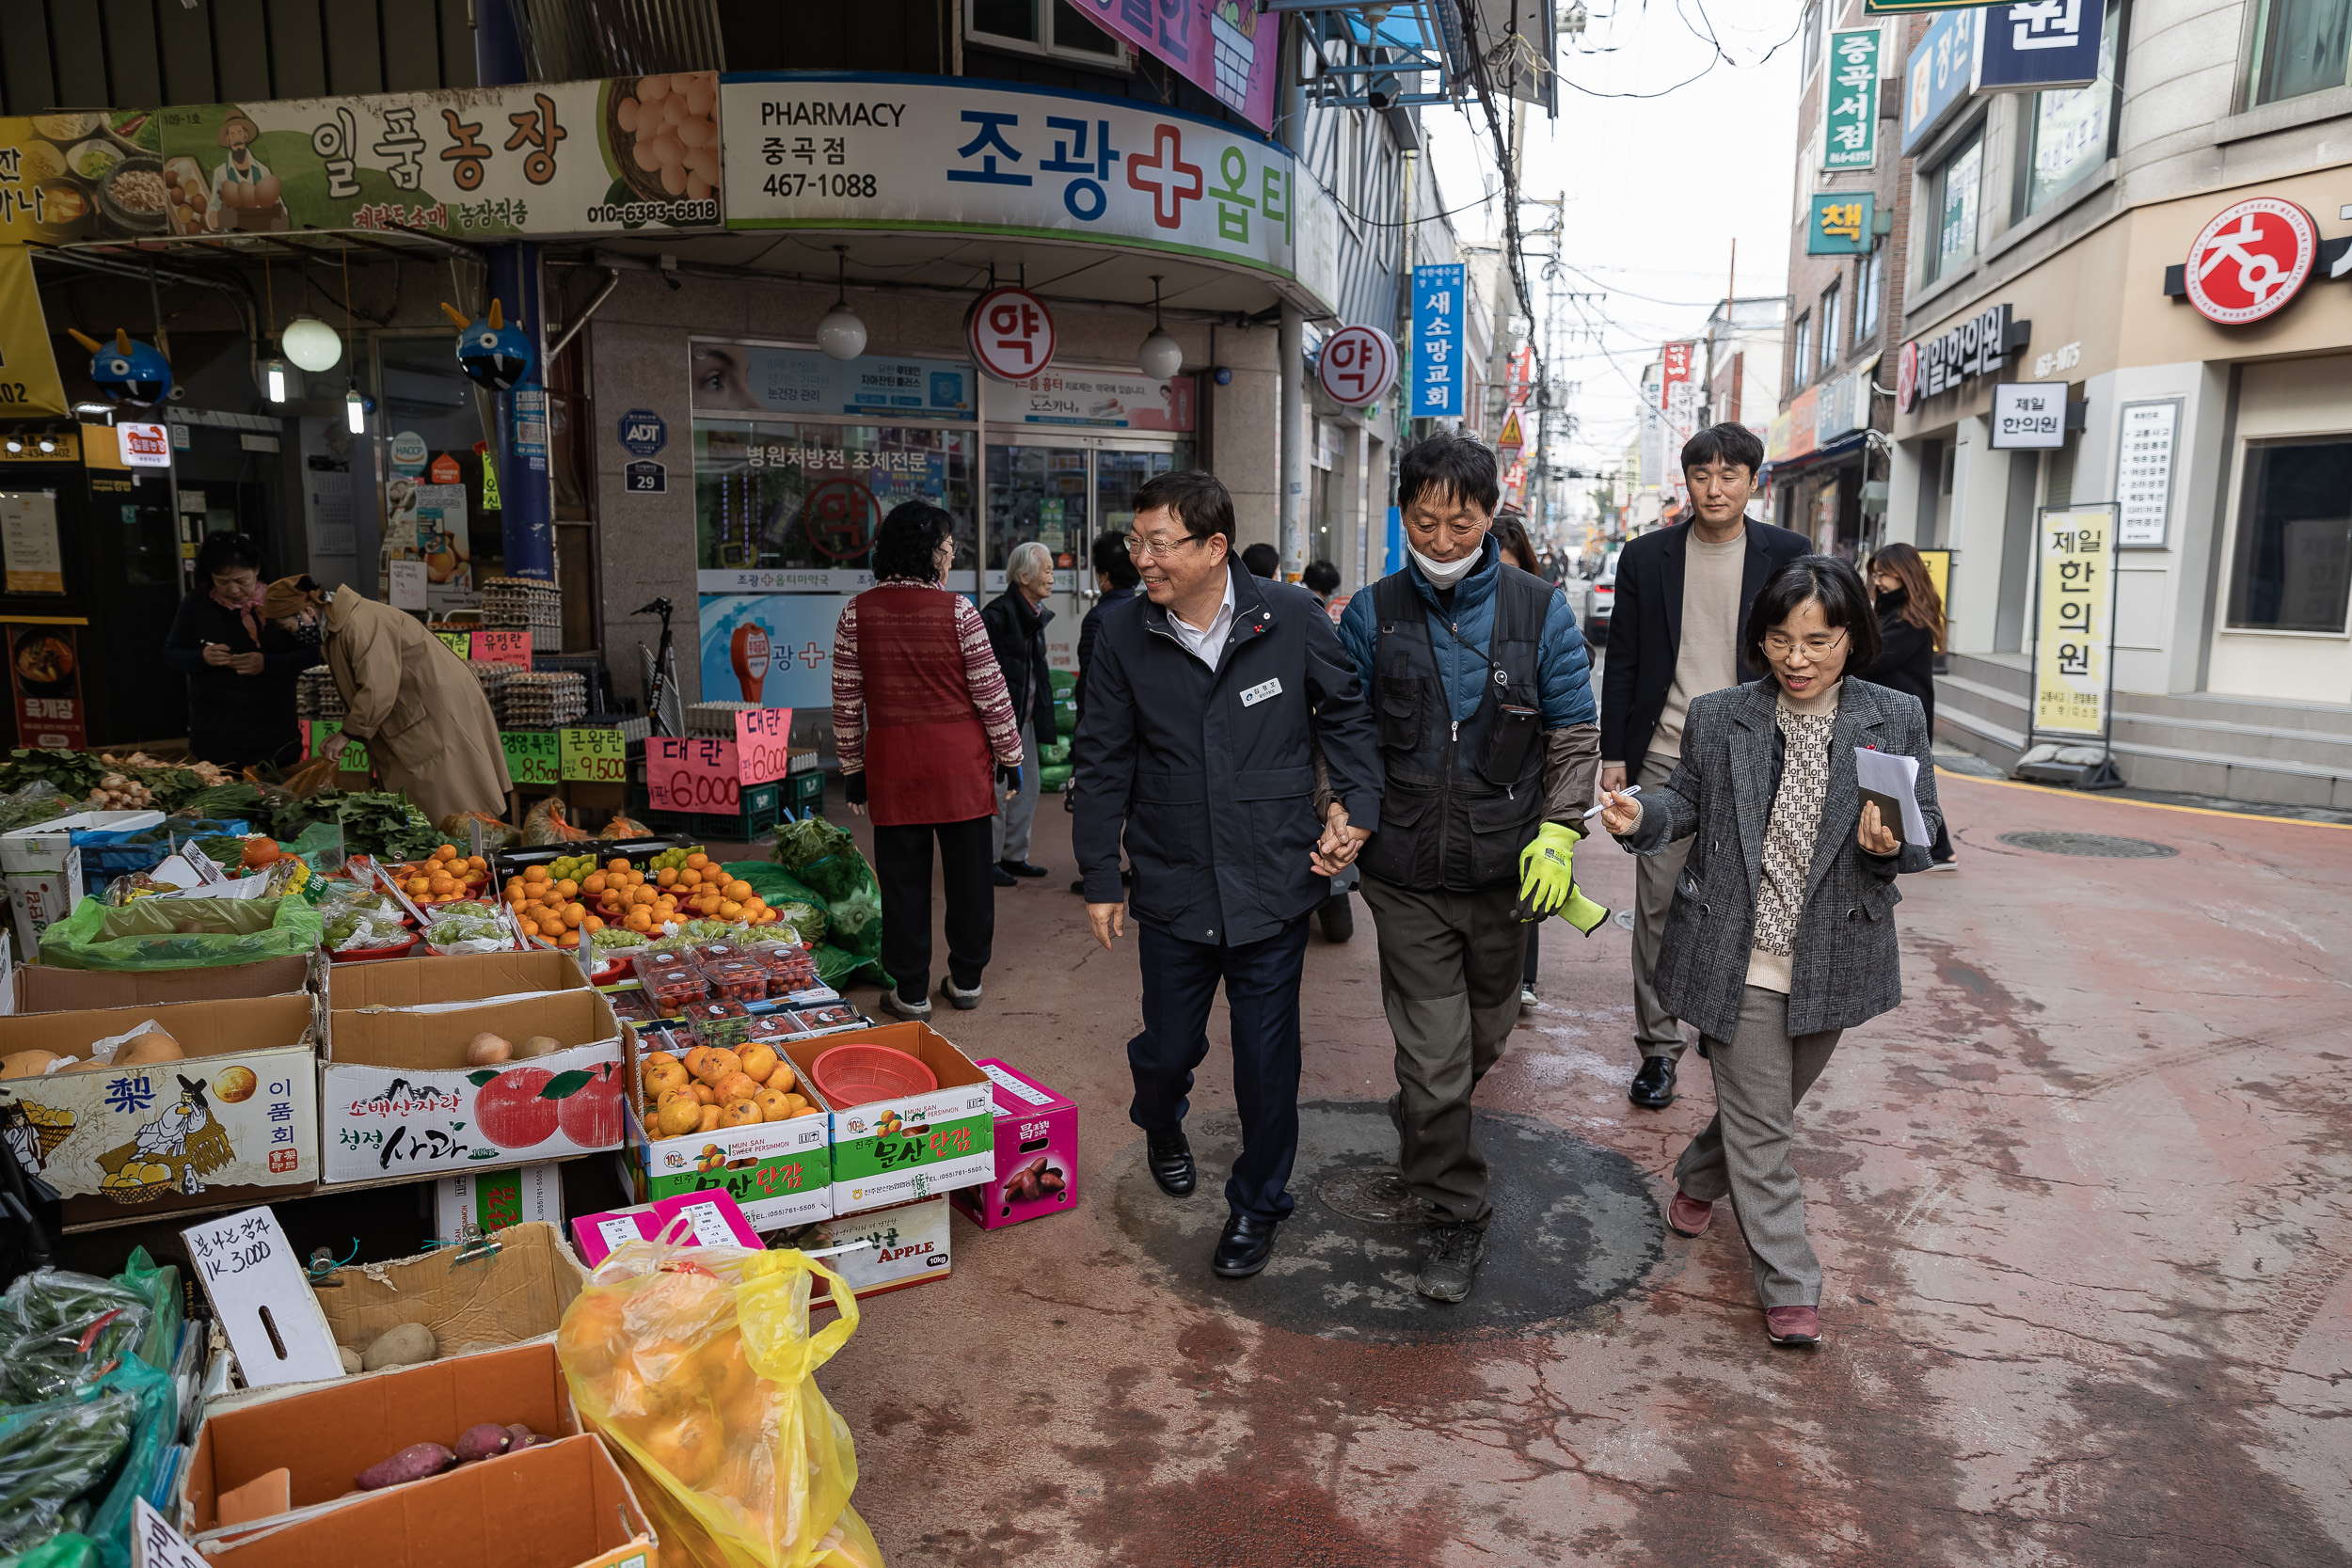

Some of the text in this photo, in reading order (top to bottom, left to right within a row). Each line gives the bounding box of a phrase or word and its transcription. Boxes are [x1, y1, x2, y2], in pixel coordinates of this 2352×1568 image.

[1832, 35, 1876, 150] 중곡서점
[164, 114, 202, 126] 109-1호
[761, 102, 906, 127] PHARMACY
[311, 92, 568, 200] 일품농장
[761, 136, 845, 166] 중곡점
[762, 173, 878, 198] 467-1088
[946, 110, 1292, 246] 조광 옵티
[457, 197, 528, 229] 농장직송
[587, 200, 718, 225] 010-6383-6818
[1820, 203, 1863, 243] 책
[1418, 267, 1461, 278] 대한예수교
[989, 303, 1041, 365] 약
[1423, 290, 1453, 411] 새소망교회
[1915, 305, 2005, 400] 제일한의원
[1330, 339, 1374, 393] 약
[0, 382, 28, 404] 02
[767, 388, 798, 401] 눈건강
[2015, 397, 2045, 412] 제일
[627, 424, 660, 442] ADT
[2002, 417, 2058, 434] 한의원
[745, 445, 929, 473] 병원처방전 조제전문
[637, 475, 656, 489] 29
[2052, 529, 2102, 554] 제일
[737, 573, 830, 587] 조광 옵티마약국
[2057, 560, 2095, 677] 한의원
[485, 633, 522, 651] 유정란
[746, 708, 781, 736] 대란
[568, 731, 624, 754] 큰왕란
[663, 738, 723, 767] 대란
[580, 756, 626, 781] 9.500
[753, 743, 788, 782] 6.000
[671, 768, 740, 809] 6.000
[103, 1076, 157, 1114] 梨
[348, 1093, 464, 1118] 소백산자락
[266, 1078, 294, 1145] 이품회
[923, 1104, 937, 1113] SAN
[927, 1106, 960, 1118] PERSIMMON
[340, 1127, 385, 1151] 청정
[379, 1124, 469, 1170] 사과
[731, 1138, 766, 1150] MUN SAN
[755, 1140, 789, 1153] PERSIMMON
[854, 1139, 874, 1150] 진주
[929, 1126, 972, 1158] 단감
[471, 1147, 496, 1158] 10kg
[874, 1138, 927, 1169] 문산
[673, 1174, 694, 1185] 진주
[756, 1162, 803, 1195] 단감
[486, 1186, 516, 1232] 단감
[231, 1240, 271, 1275] 3.000
[876, 1241, 935, 1264] APPLE
[929, 1255, 946, 1265] 10kg
